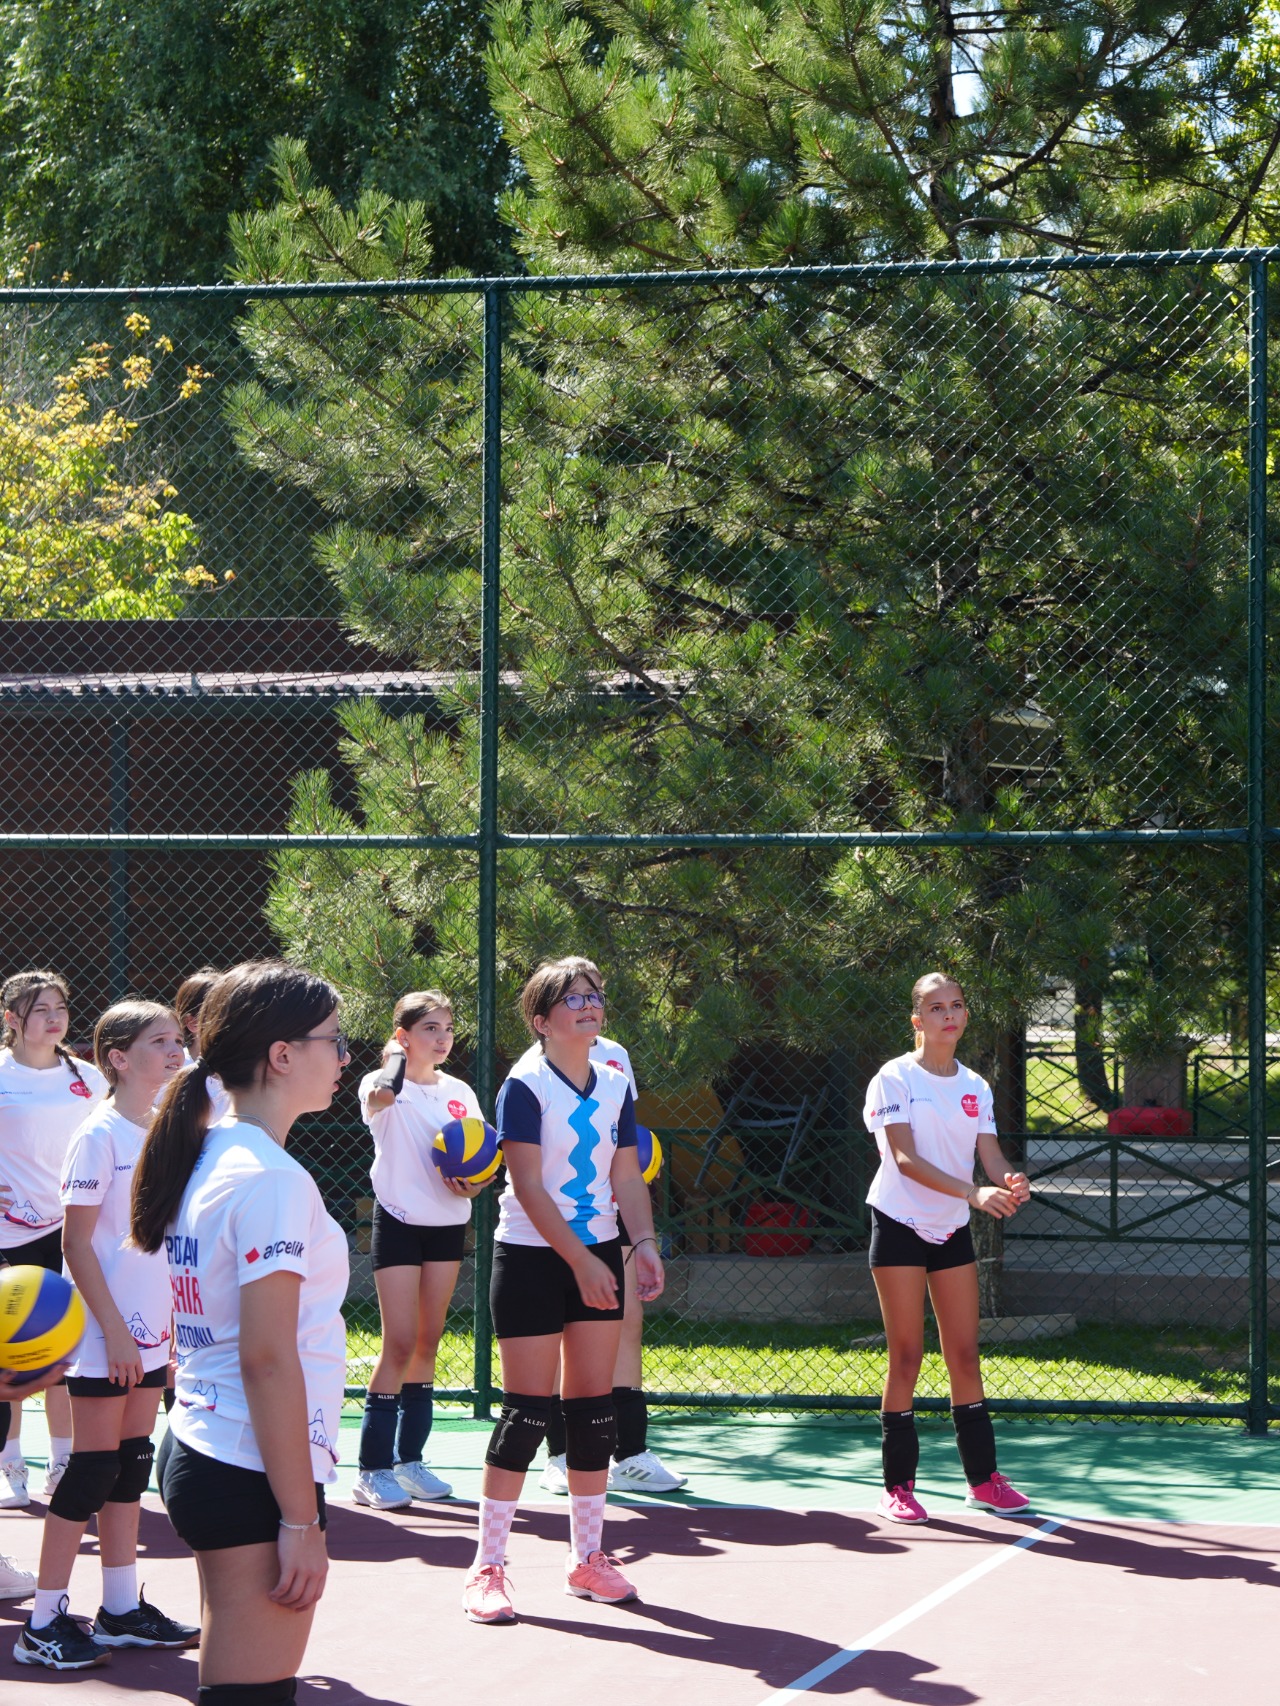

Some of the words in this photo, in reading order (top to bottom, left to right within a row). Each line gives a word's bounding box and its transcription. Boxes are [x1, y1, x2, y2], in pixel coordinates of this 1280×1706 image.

[263, 1240, 304, 1260] arçelik
[522, 1416, 546, 1427] ALLSIX
[591, 1415, 614, 1425] ALLSIX
